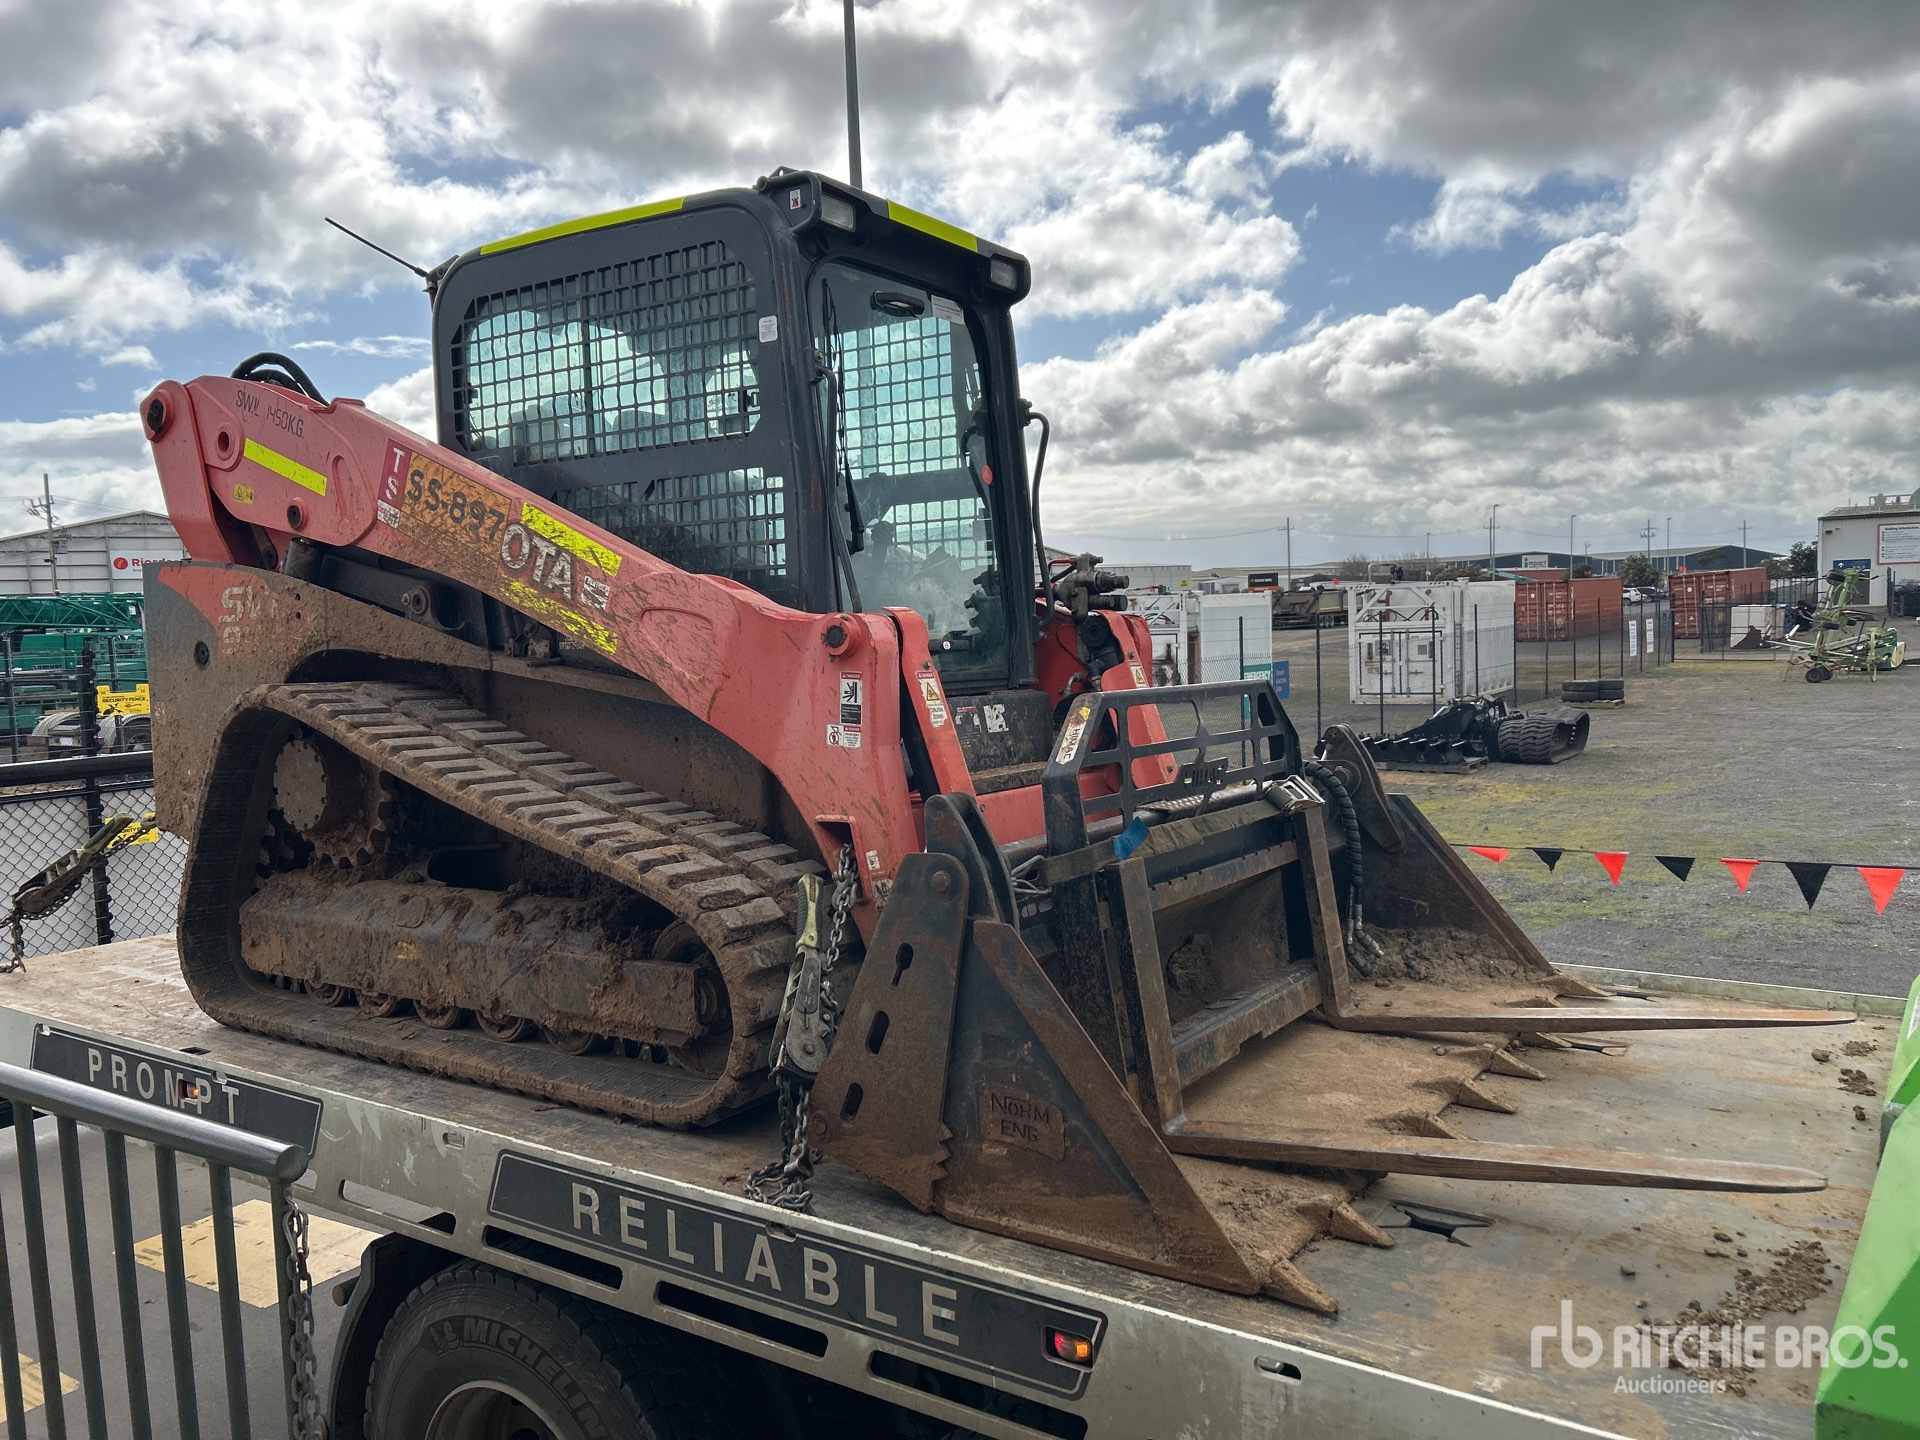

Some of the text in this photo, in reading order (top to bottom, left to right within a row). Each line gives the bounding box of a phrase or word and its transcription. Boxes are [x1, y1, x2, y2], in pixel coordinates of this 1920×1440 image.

[1063, 728, 1081, 760] HIMAC
[87, 1047, 240, 1125] PROMPT
[1000, 1119, 1039, 1142] ENG
[571, 1182, 961, 1347] RELIABLE
[463, 1317, 612, 1440] MICHELIN
